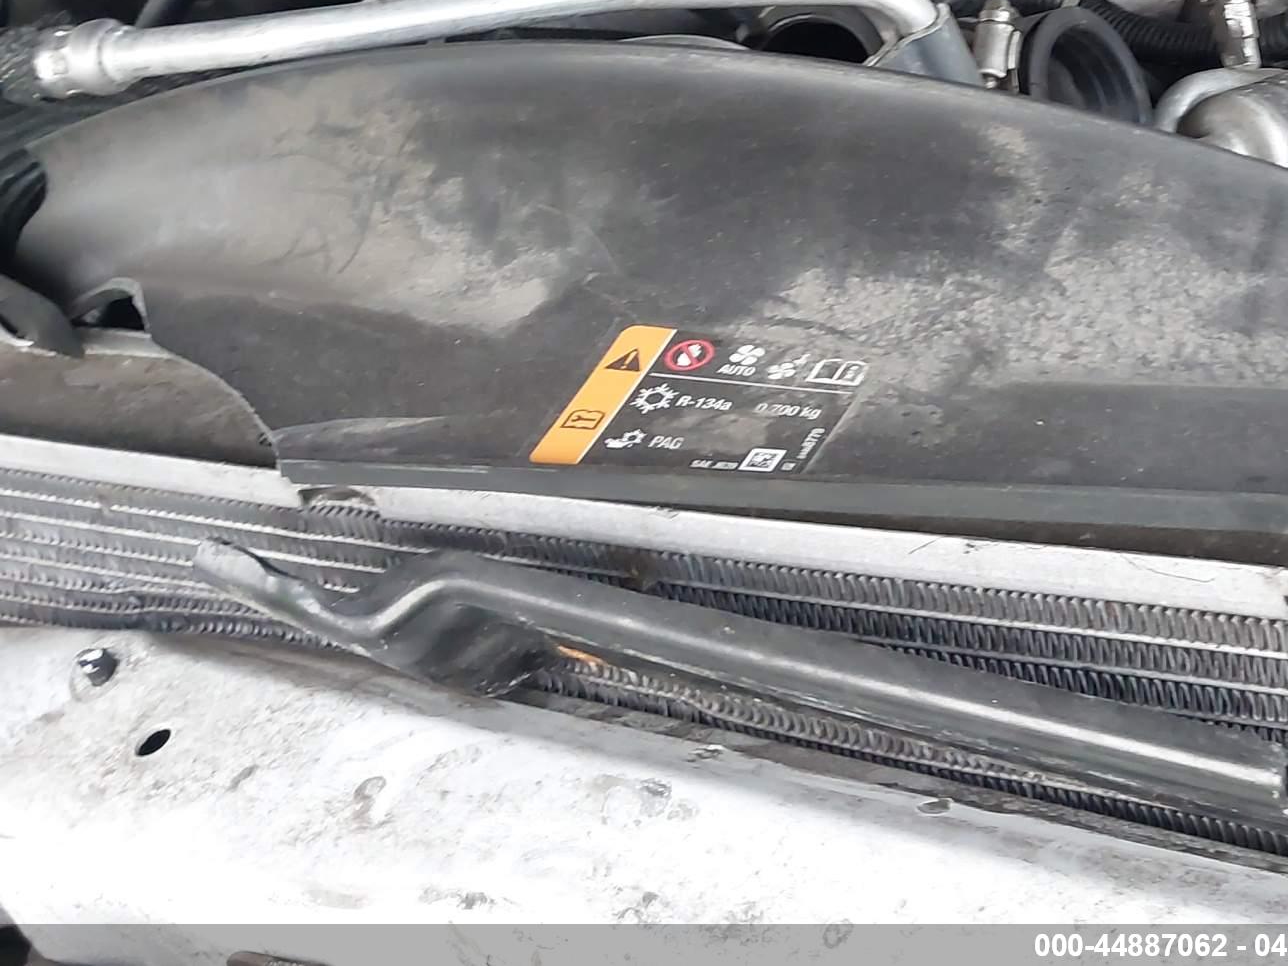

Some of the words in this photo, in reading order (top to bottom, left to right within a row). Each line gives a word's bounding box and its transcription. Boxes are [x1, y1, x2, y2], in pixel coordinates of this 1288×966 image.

[716, 364, 756, 377] AUTO
[675, 395, 734, 411] R-134a
[799, 406, 823, 420] kg
[648, 435, 685, 449] PAG
